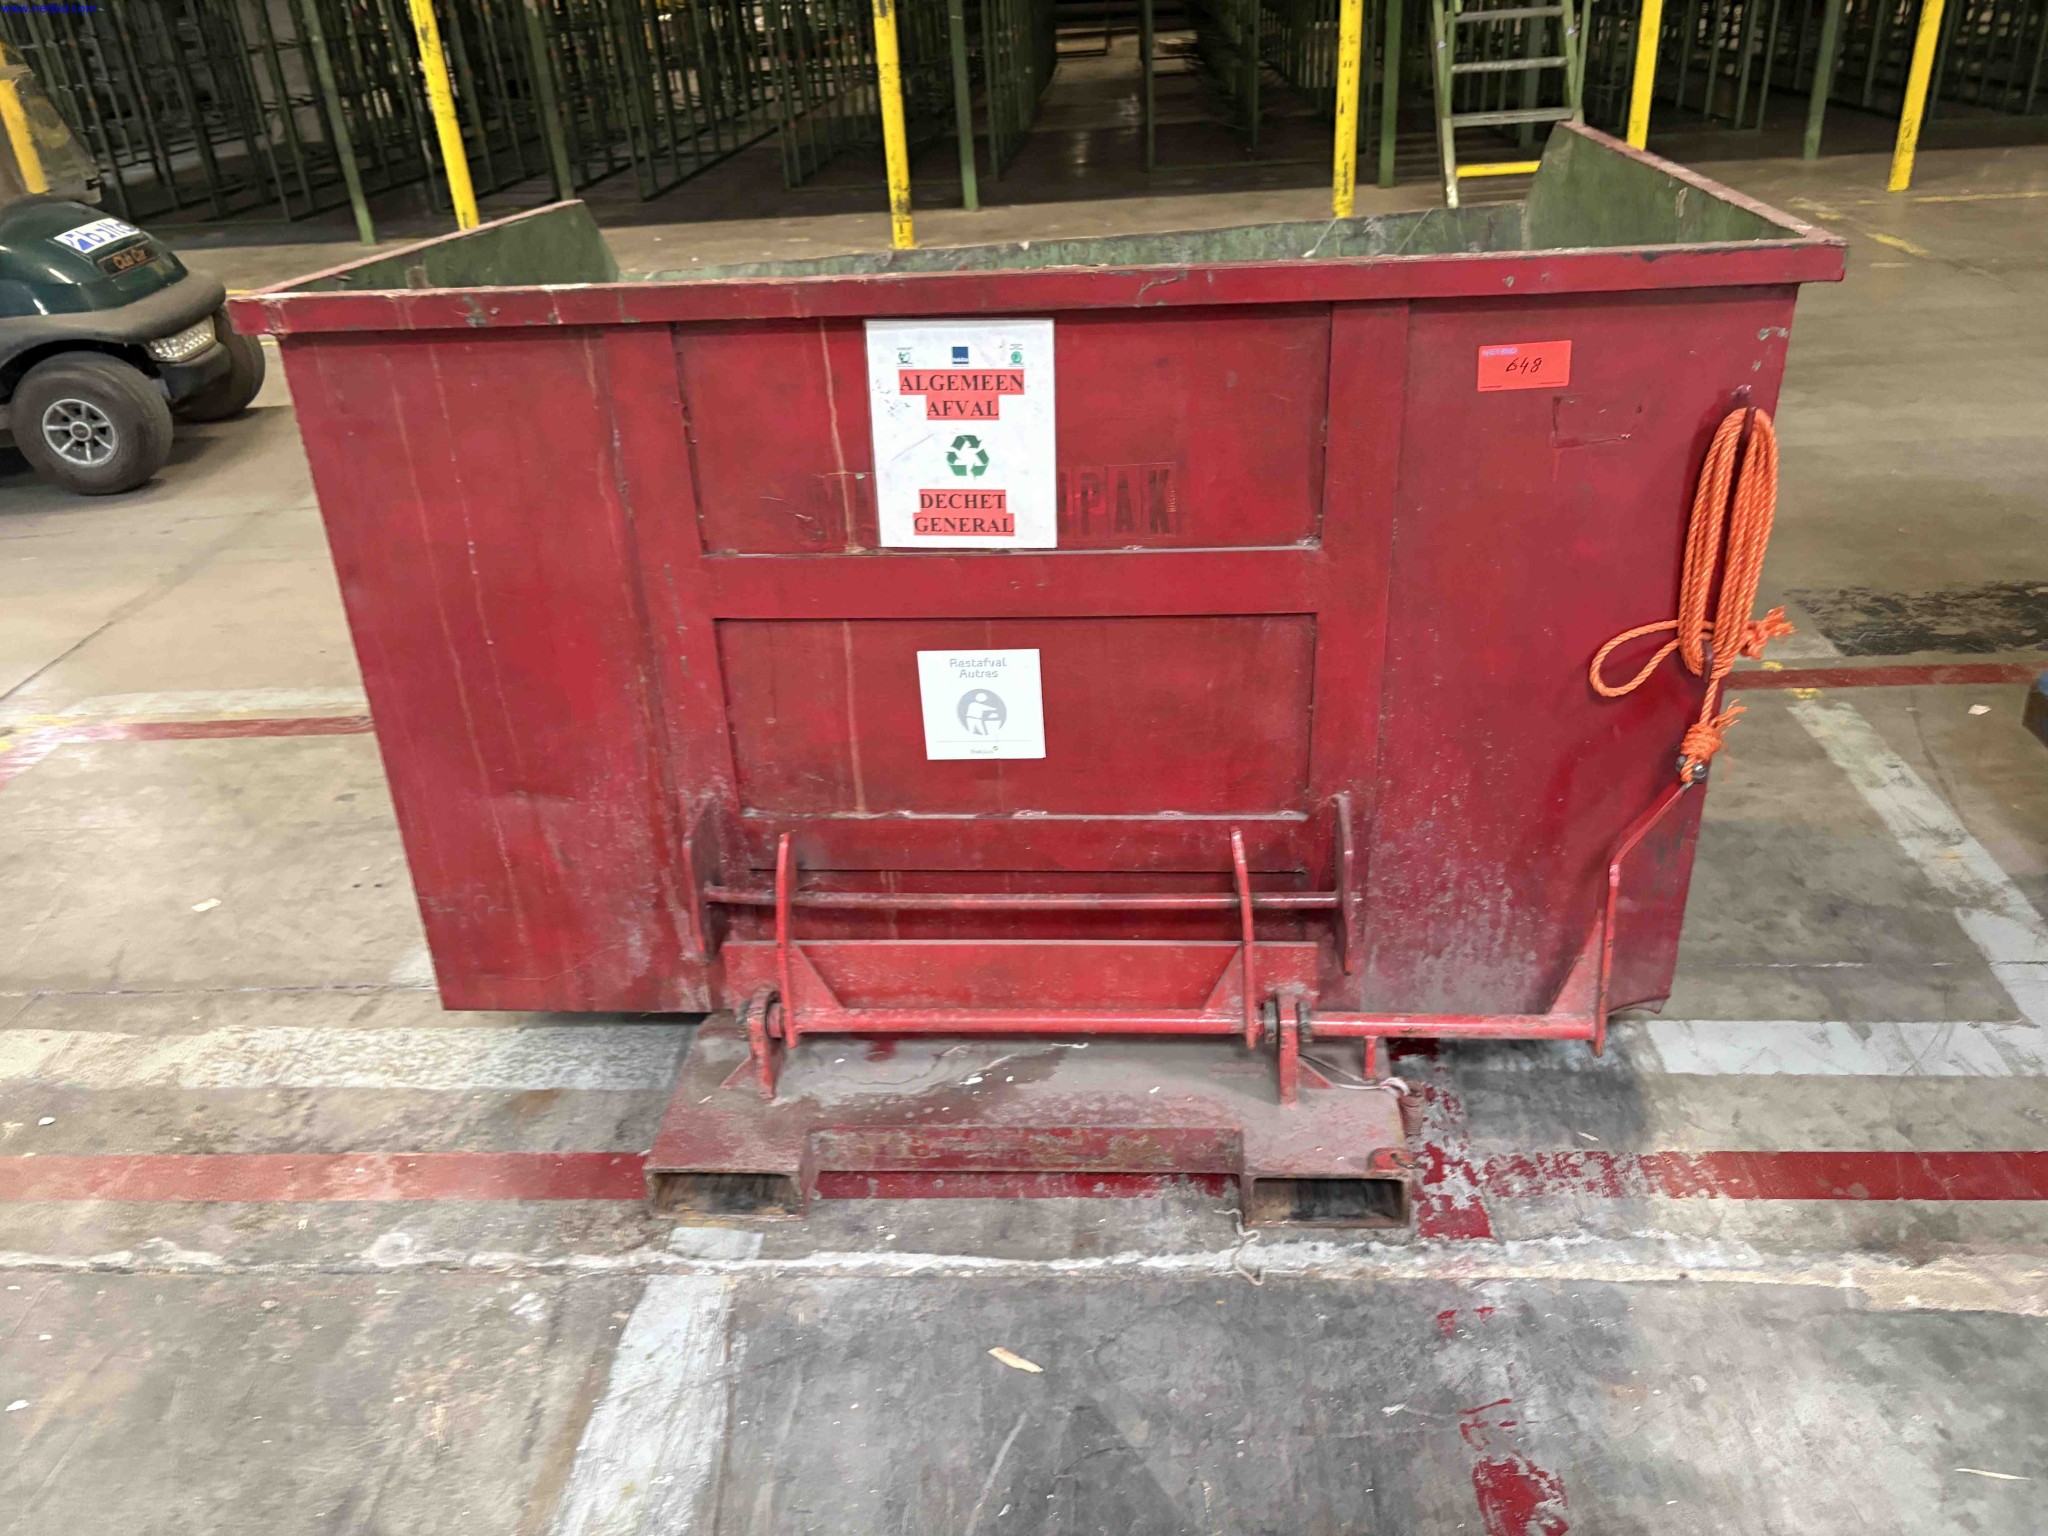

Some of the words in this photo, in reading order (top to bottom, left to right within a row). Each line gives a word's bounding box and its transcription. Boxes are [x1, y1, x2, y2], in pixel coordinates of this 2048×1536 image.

[1505, 357, 1542, 375] 648
[900, 374, 1024, 391] ALGEMEEN
[927, 400, 999, 417] AFVAL
[920, 493, 1006, 509] DECHET
[914, 516, 1015, 533] GENERAL
[949, 658, 1008, 668] Restafval
[959, 668, 999, 678] Autres
